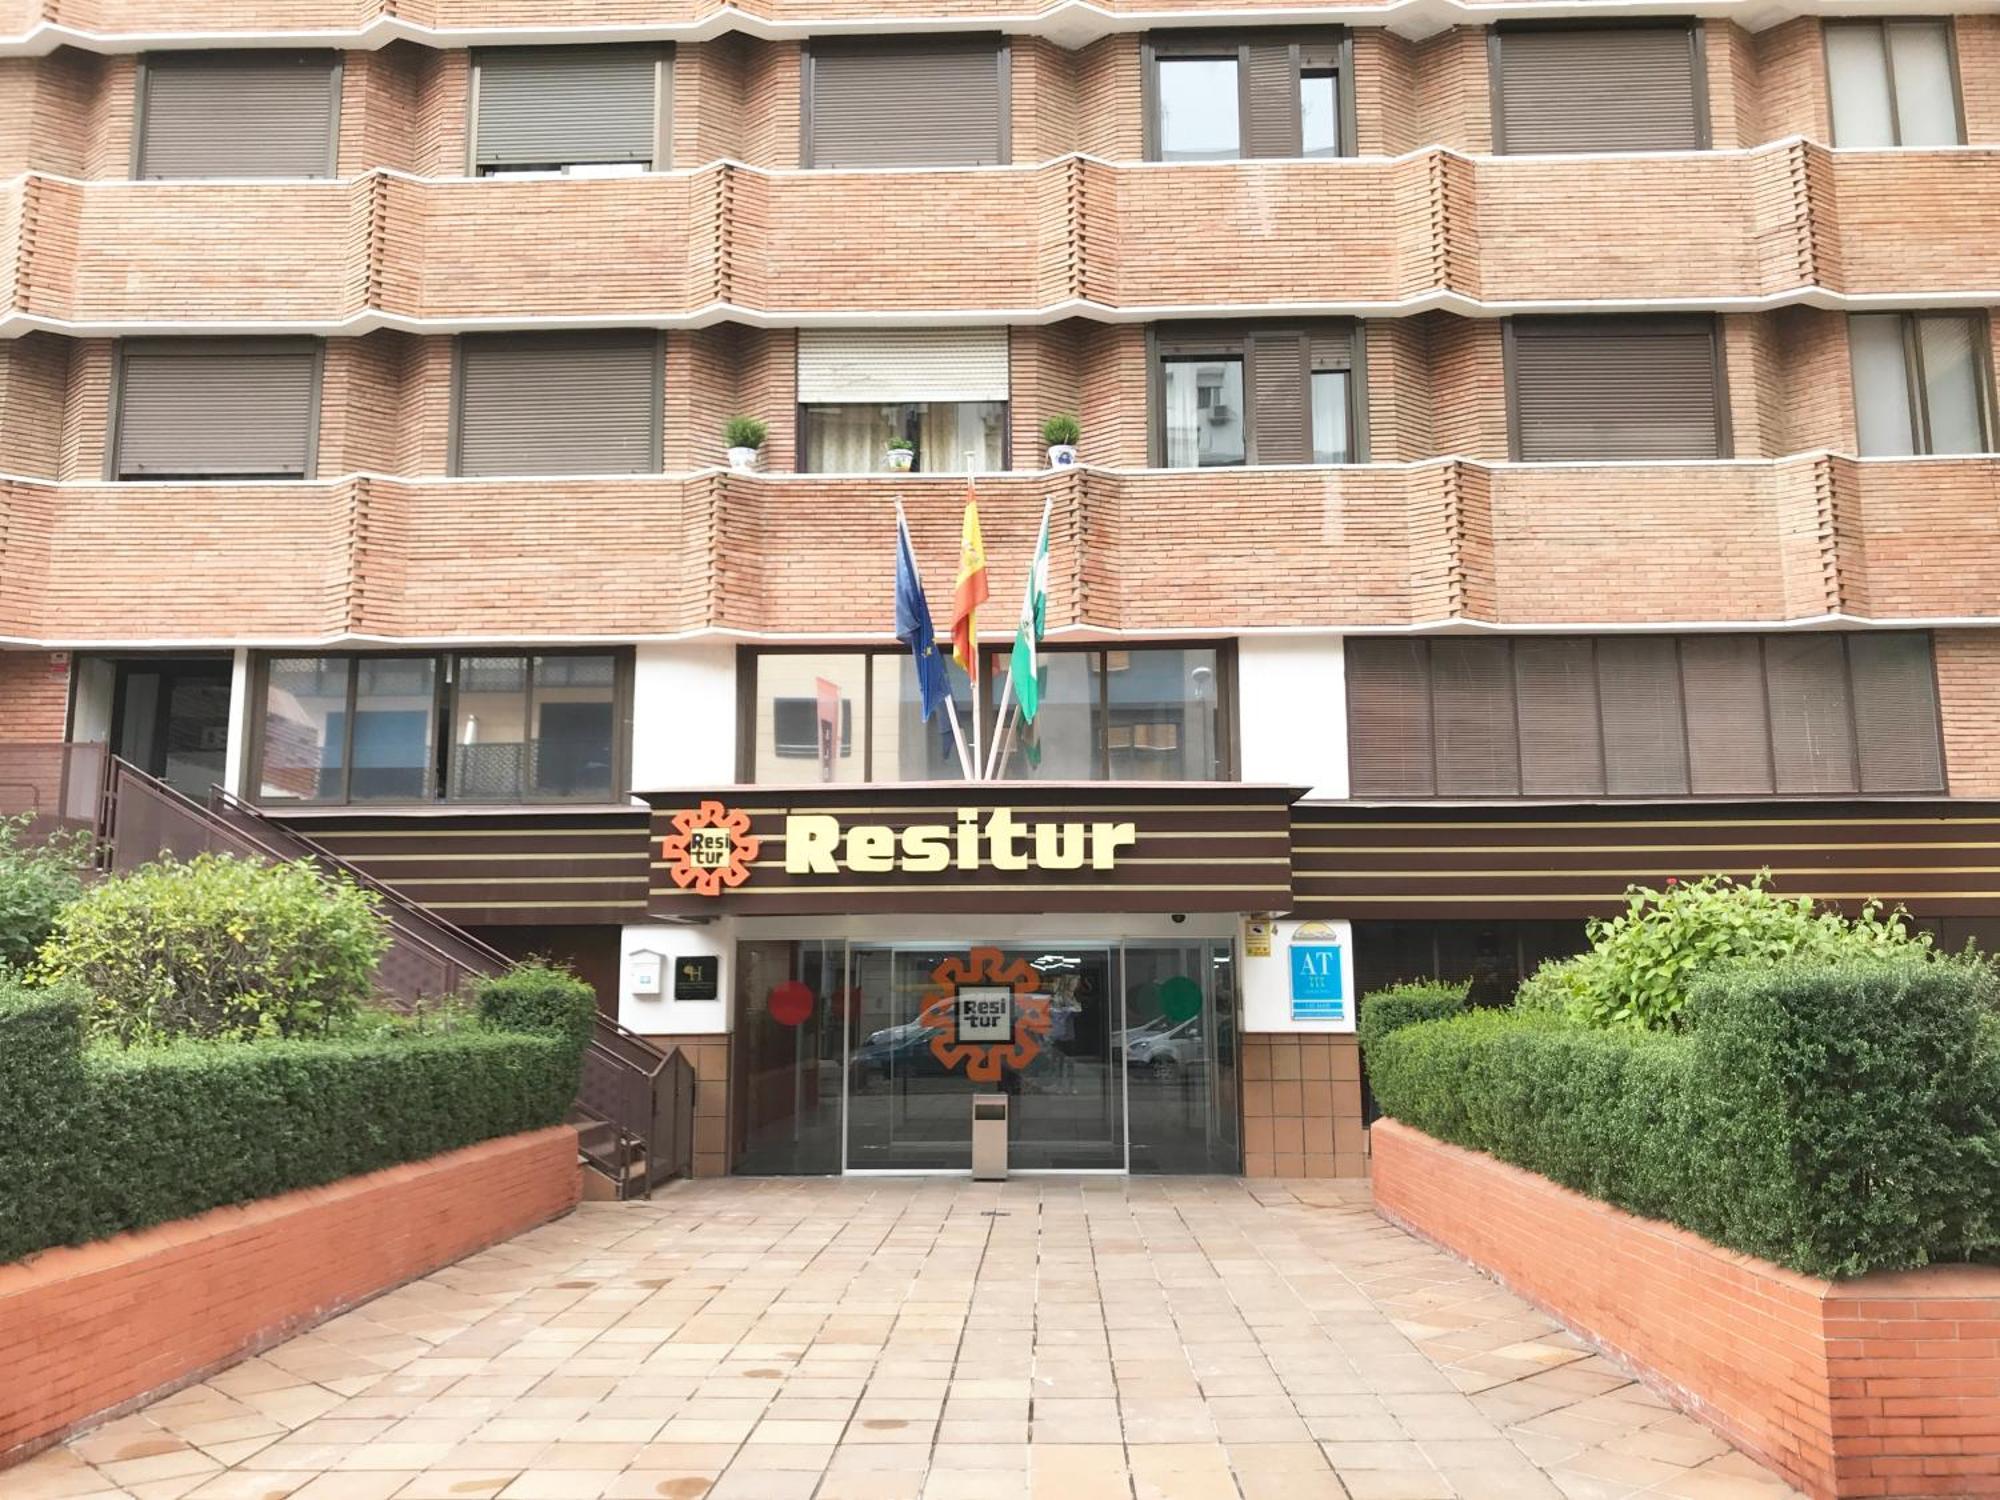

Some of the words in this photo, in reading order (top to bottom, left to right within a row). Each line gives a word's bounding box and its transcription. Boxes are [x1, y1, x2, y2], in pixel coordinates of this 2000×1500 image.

[691, 833, 730, 849] Resi
[785, 807, 1135, 874] Resitur
[690, 851, 723, 864] tur
[1300, 951, 1334, 976] AT
[963, 998, 1006, 1015] Resi
[963, 1014, 1001, 1028] tur
